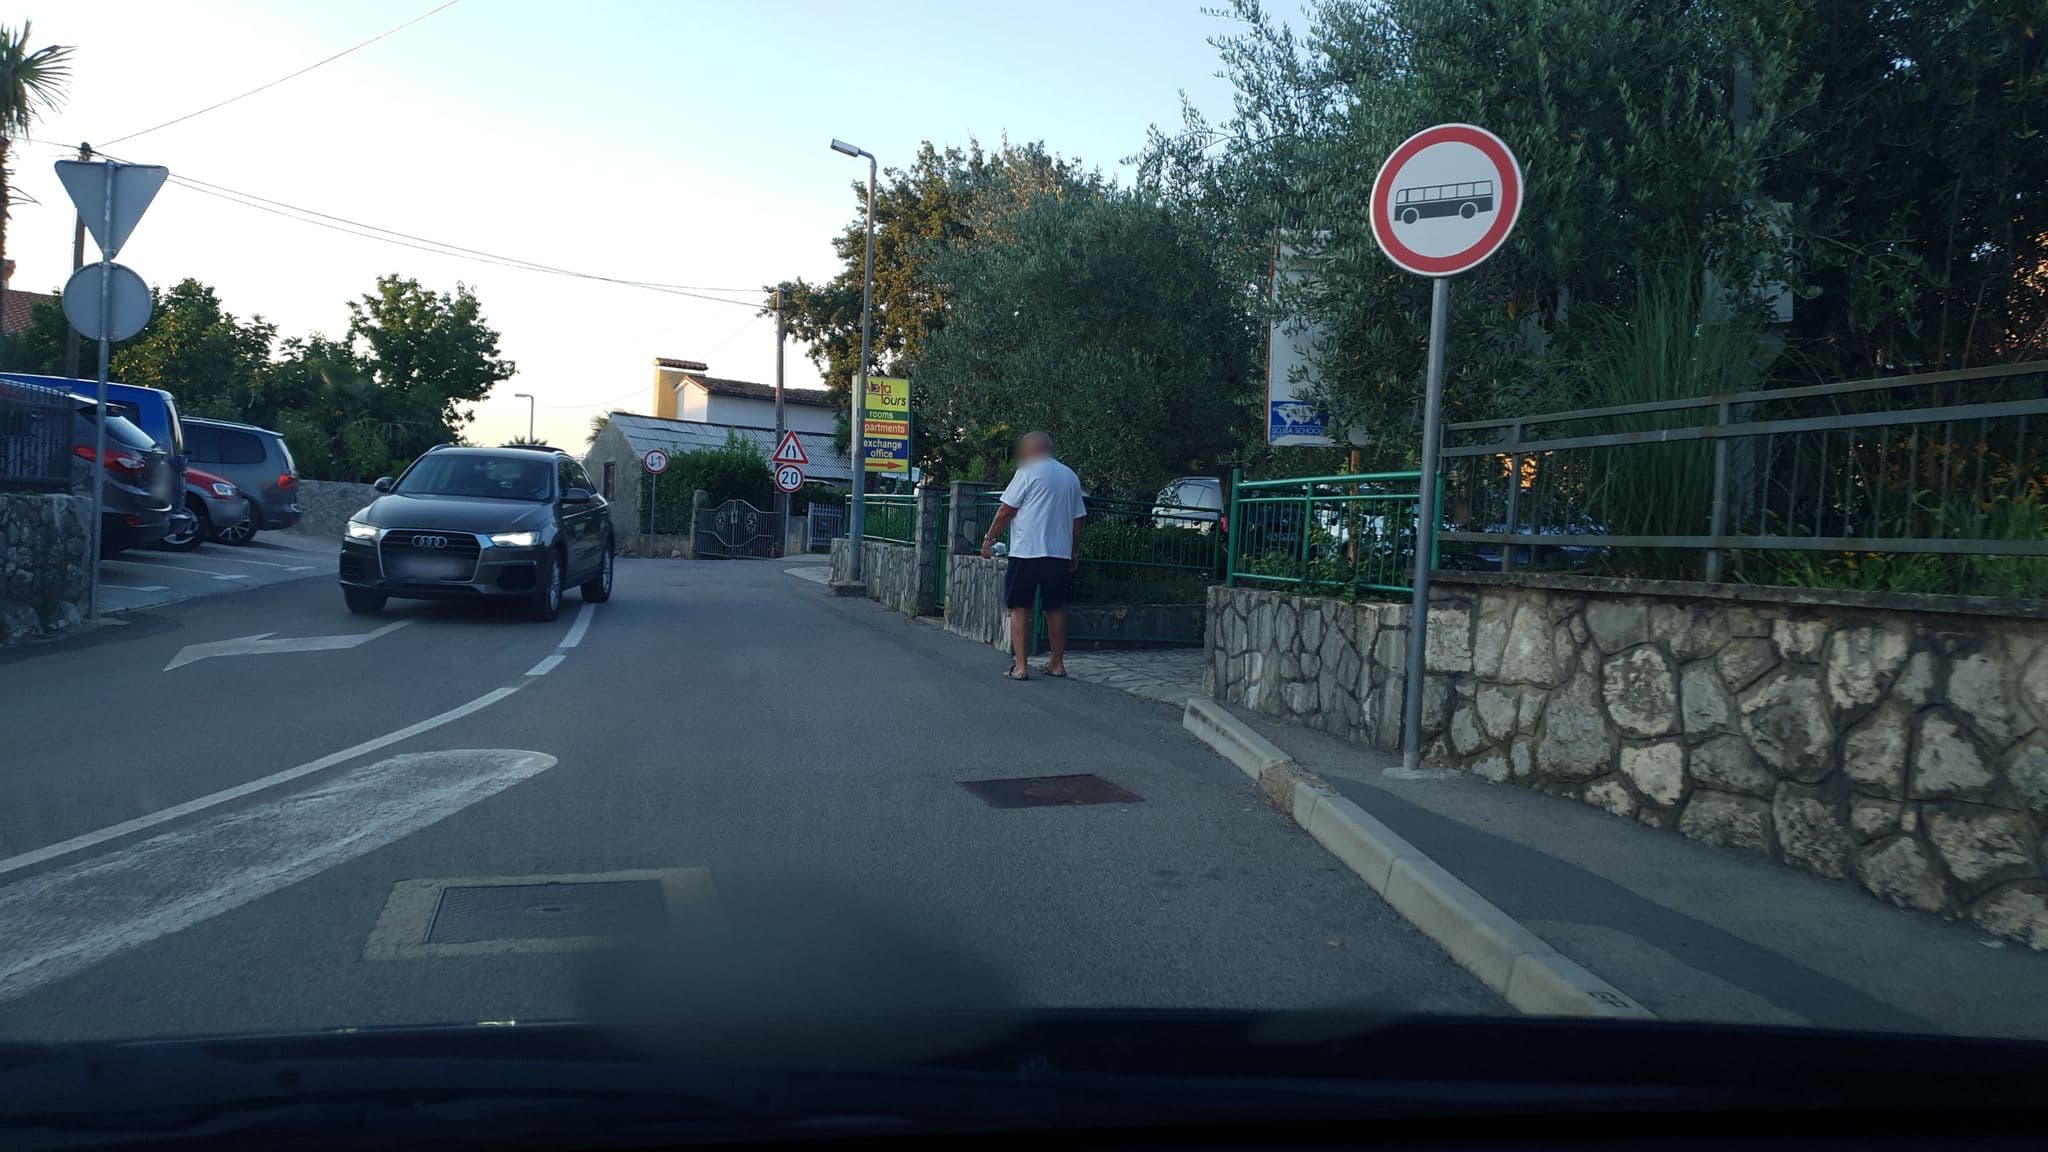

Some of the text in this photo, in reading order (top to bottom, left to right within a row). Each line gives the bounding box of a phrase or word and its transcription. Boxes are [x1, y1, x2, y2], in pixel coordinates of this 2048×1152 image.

[869, 410, 894, 419] rooms
[864, 423, 905, 433] partments
[863, 439, 902, 451] exchange
[870, 449, 893, 459] office
[782, 472, 798, 485] 20
